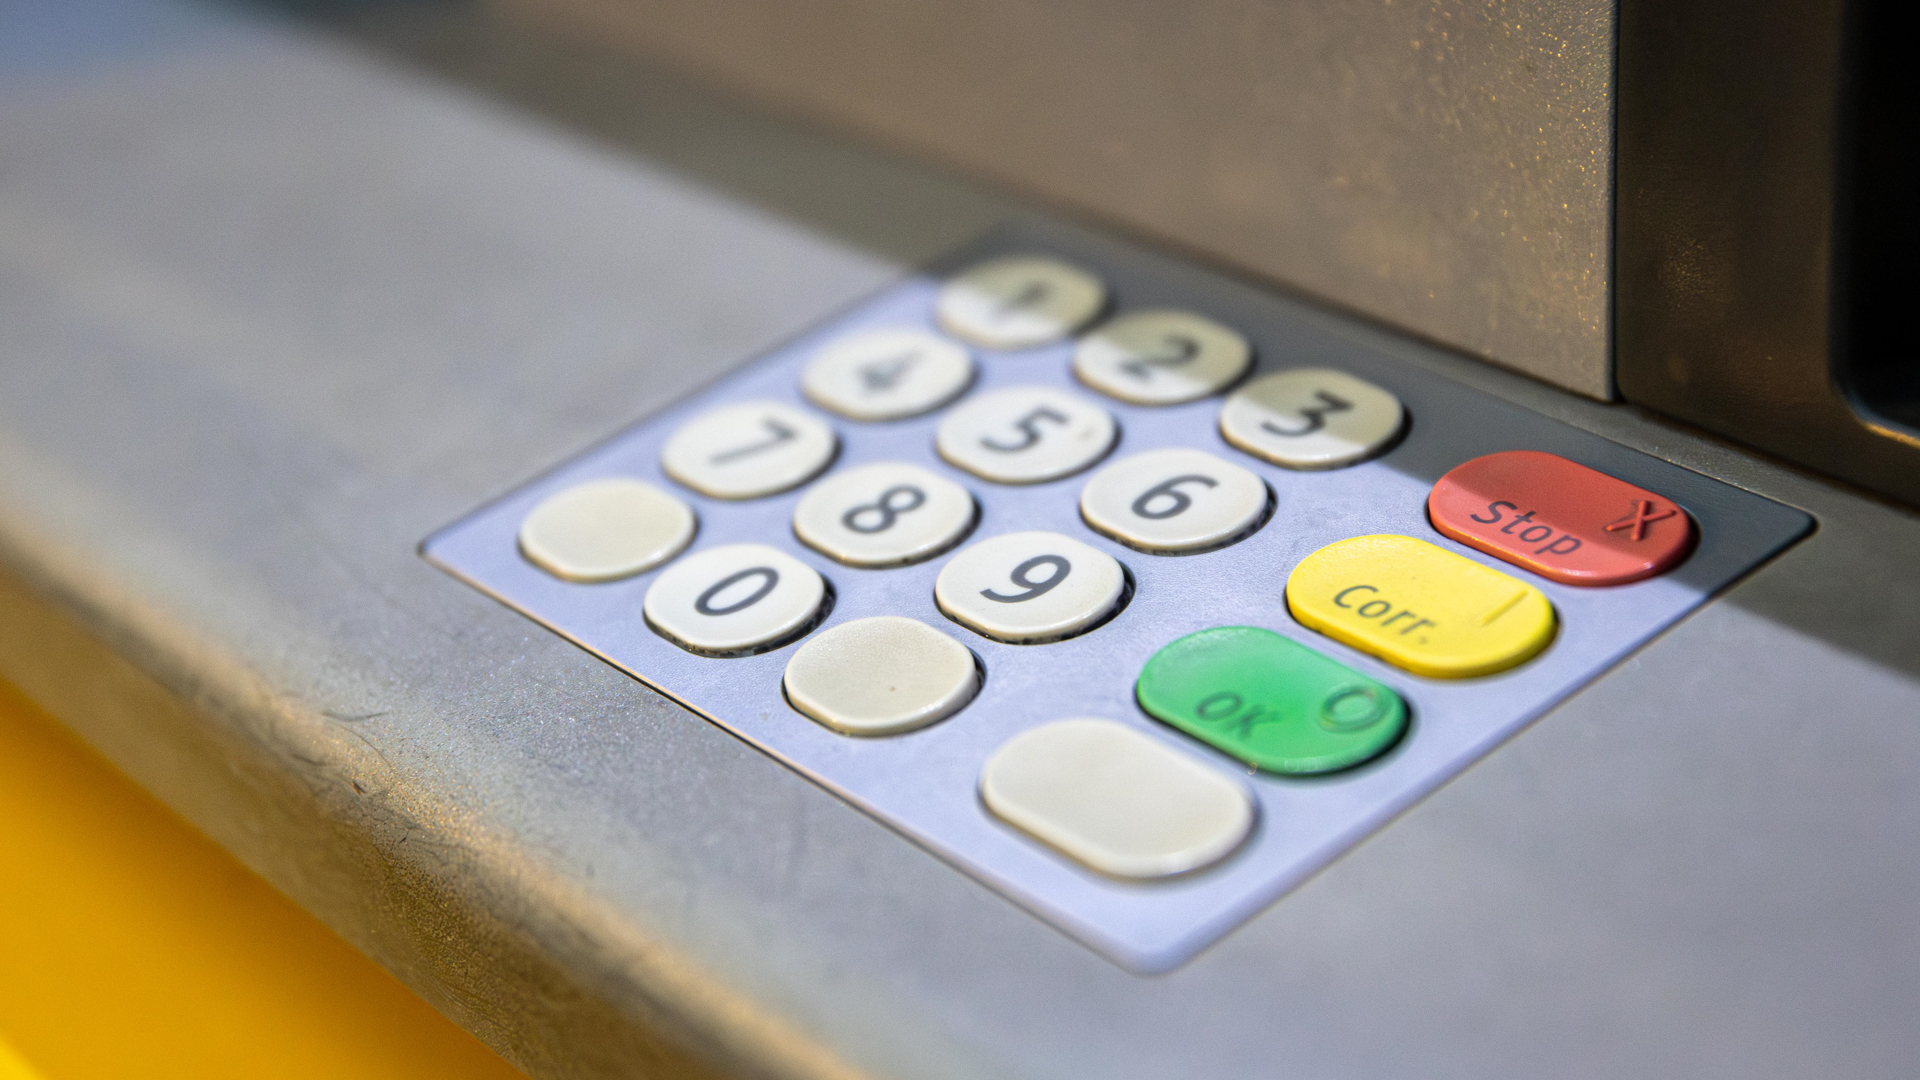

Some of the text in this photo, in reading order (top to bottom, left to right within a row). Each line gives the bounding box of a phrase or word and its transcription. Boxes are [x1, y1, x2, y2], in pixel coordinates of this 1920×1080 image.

[856, 349, 928, 392] 4
[1119, 334, 1203, 381] 2
[979, 406, 1071, 453] 5
[1260, 390, 1356, 438] 3
[708, 418, 798, 465] 7
[841, 484, 927, 535] 8
[1131, 474, 1220, 521] 6
[1470, 499, 1584, 557] Stop
[694, 566, 780, 617] 0
[979, 554, 1072, 603] 9
[1332, 583, 1438, 645] Corr.
[1195, 690, 1281, 740] OK
